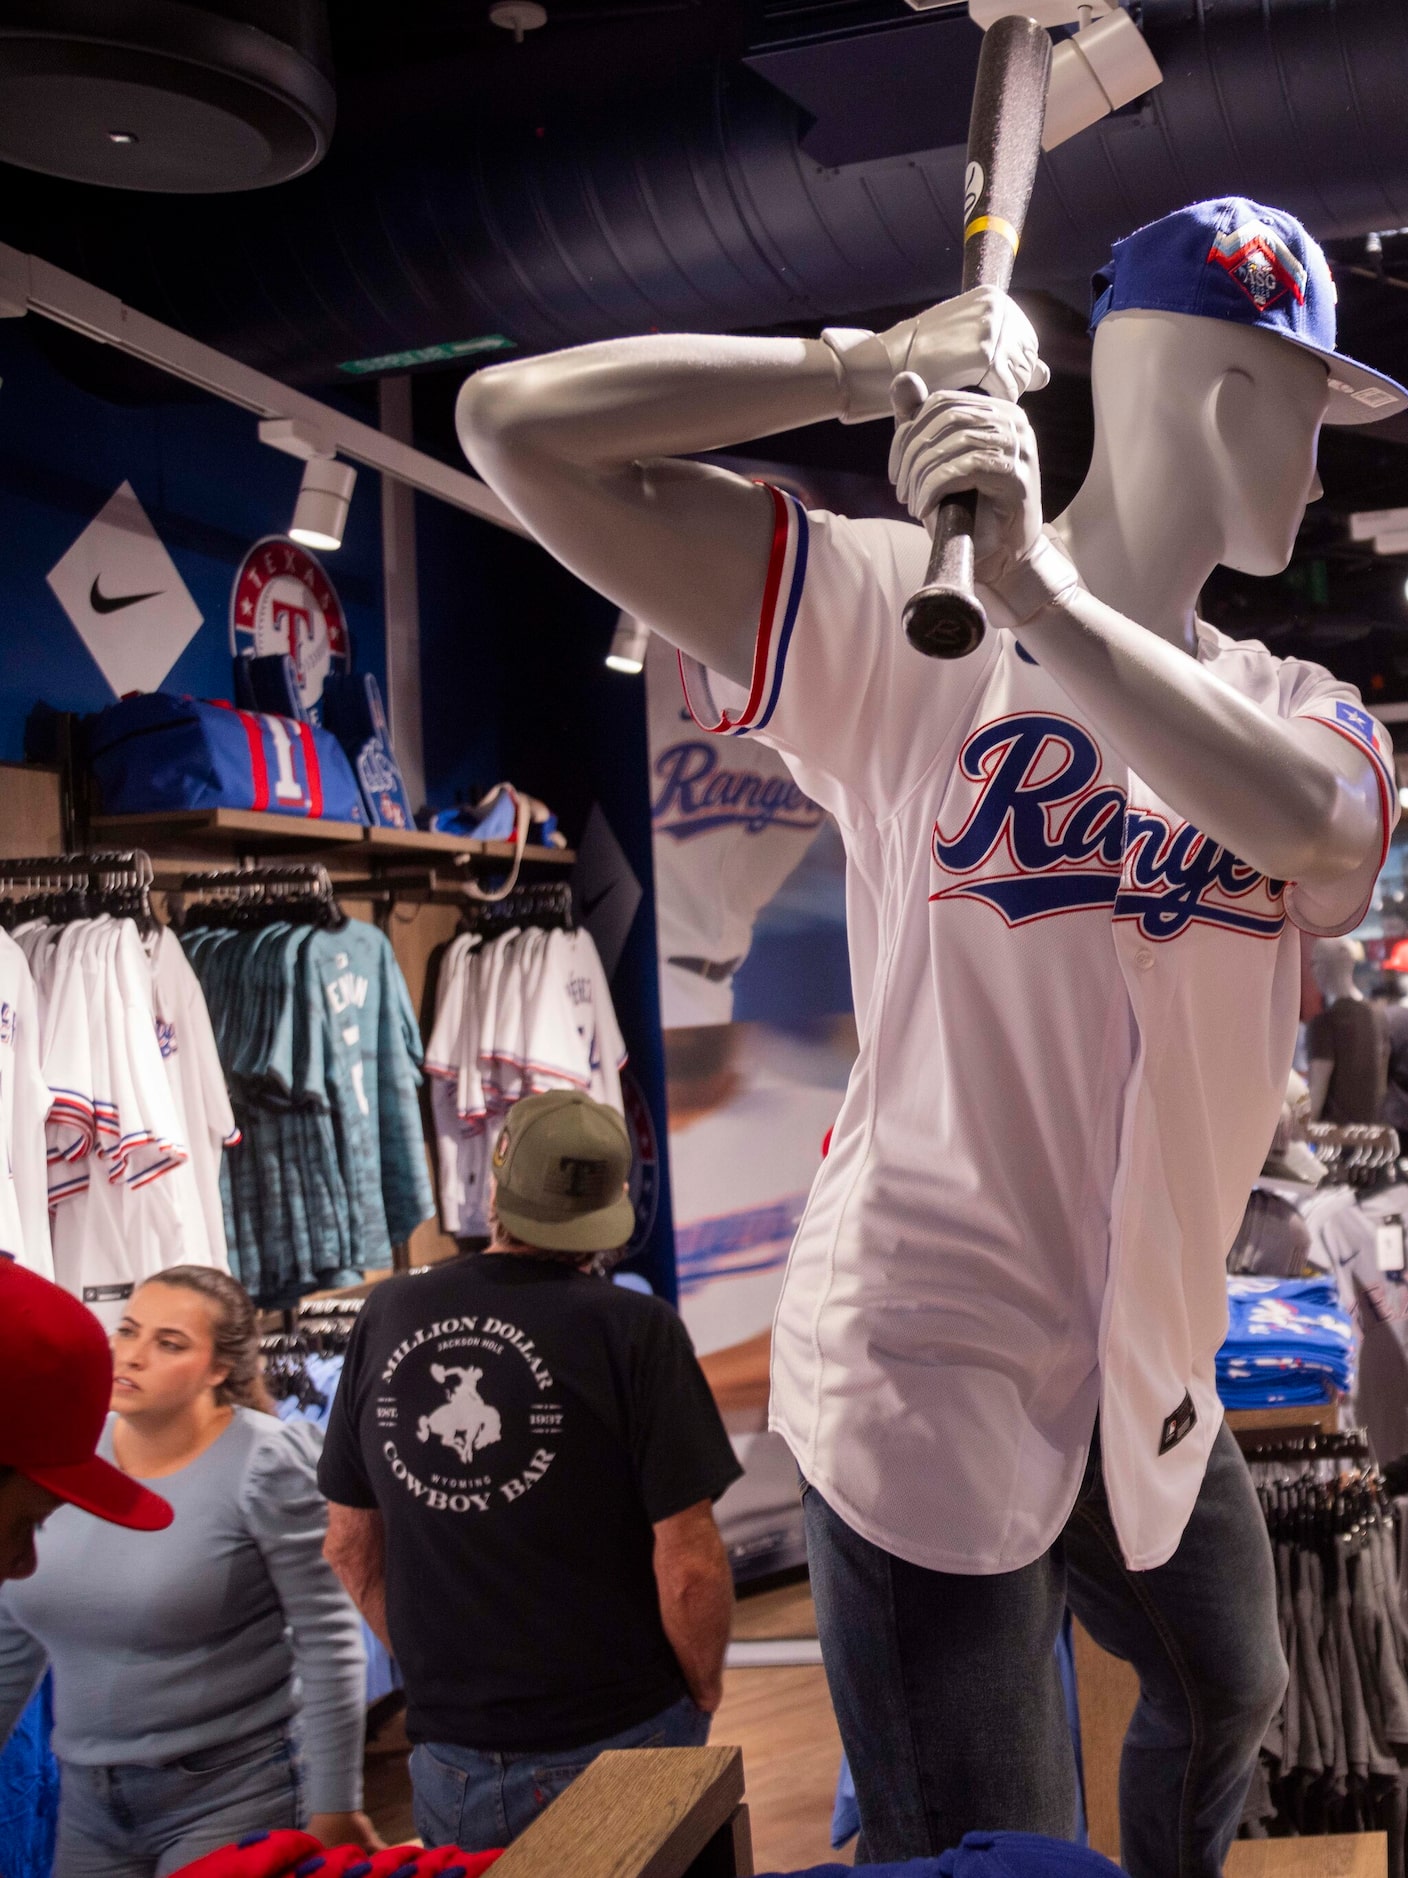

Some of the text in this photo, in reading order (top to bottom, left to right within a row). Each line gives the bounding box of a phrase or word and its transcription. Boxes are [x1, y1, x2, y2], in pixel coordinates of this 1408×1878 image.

[1243, 266, 1276, 290] ASG
[247, 549, 331, 609] TEXAS
[381, 1315, 554, 1391] MILLION DOLLAR
[437, 1337, 505, 1355] JACKSON HOLE
[529, 1413, 564, 1426] 1937
[384, 1440, 556, 1513] COWBOY BAR
[431, 1473, 492, 1489] WYOMING
